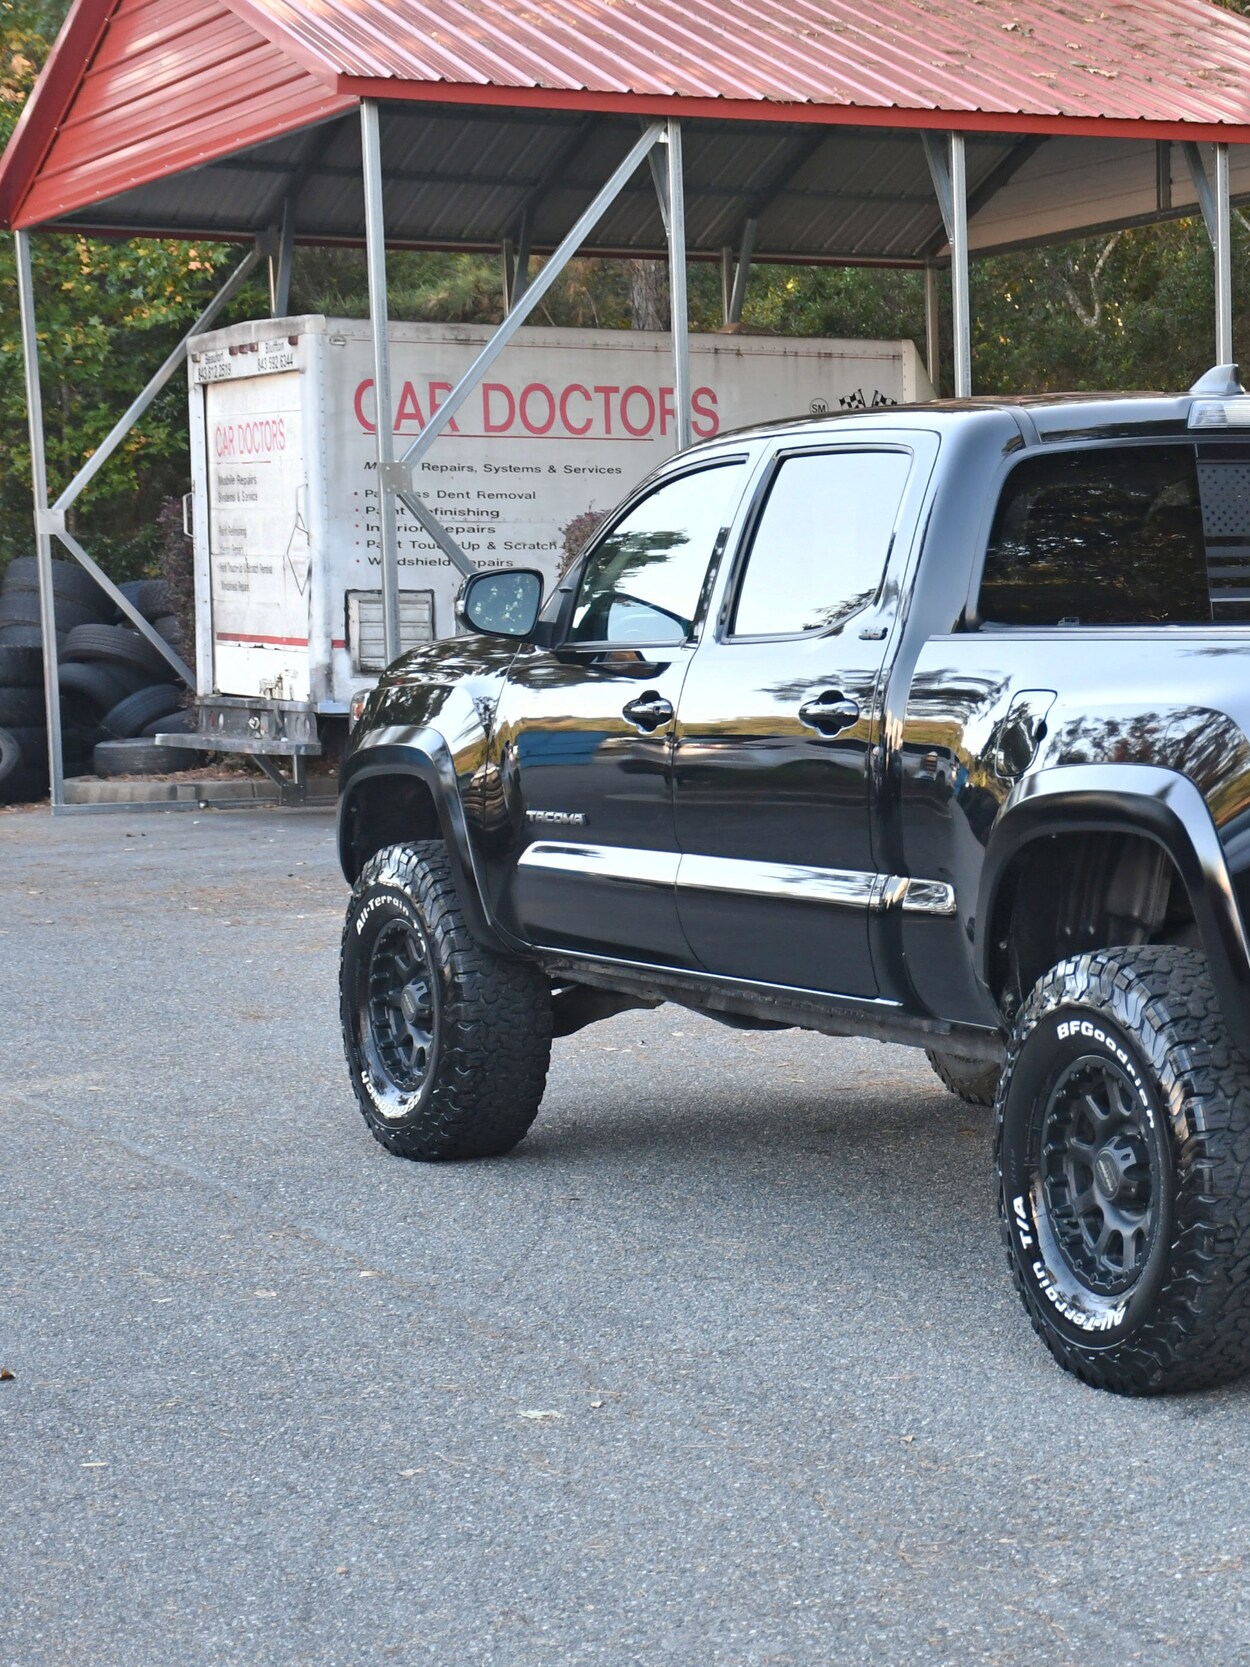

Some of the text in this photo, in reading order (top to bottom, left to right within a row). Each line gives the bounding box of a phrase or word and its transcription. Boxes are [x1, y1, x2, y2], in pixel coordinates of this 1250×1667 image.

[215, 425, 236, 457] CAR
[421, 463, 622, 474] Repairs, Systems & Services
[436, 490, 470, 499] Dent
[477, 491, 536, 500] Removal
[366, 523, 496, 535] Inrior epairs
[486, 541, 496, 550] &
[503, 541, 557, 550] Scratch
[368, 557, 451, 567] Wdshield
[526, 809, 586, 825] TACOMA
[356, 895, 409, 935] All-Terrain
[1056, 1020, 1155, 1129] BFGoodrich
[1012, 1195, 1032, 1250] T/A
